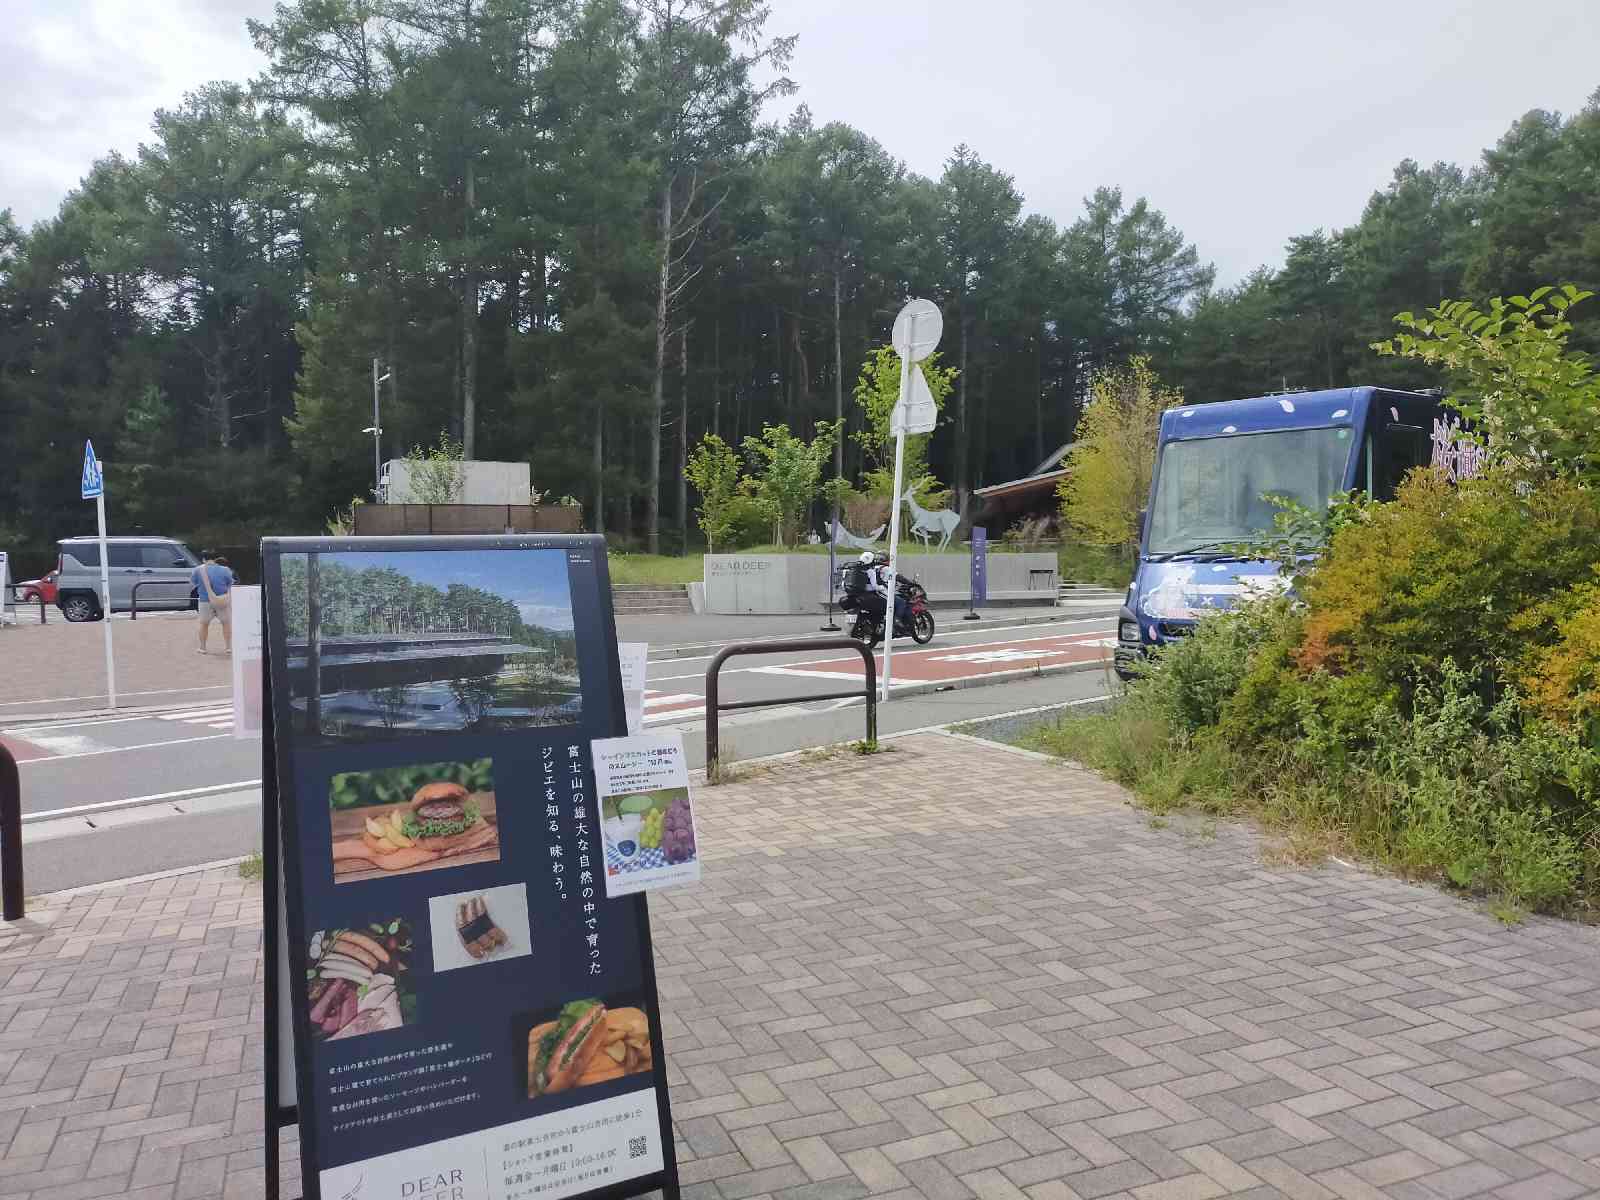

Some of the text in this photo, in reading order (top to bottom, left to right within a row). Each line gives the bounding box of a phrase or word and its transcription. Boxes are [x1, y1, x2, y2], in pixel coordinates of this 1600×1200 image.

[541, 746, 567, 899] ジビエを知る、味わう。
[567, 744, 601, 976] 富士山の雄大な自然の中で育った
[401, 1169, 463, 1198] DEAR
